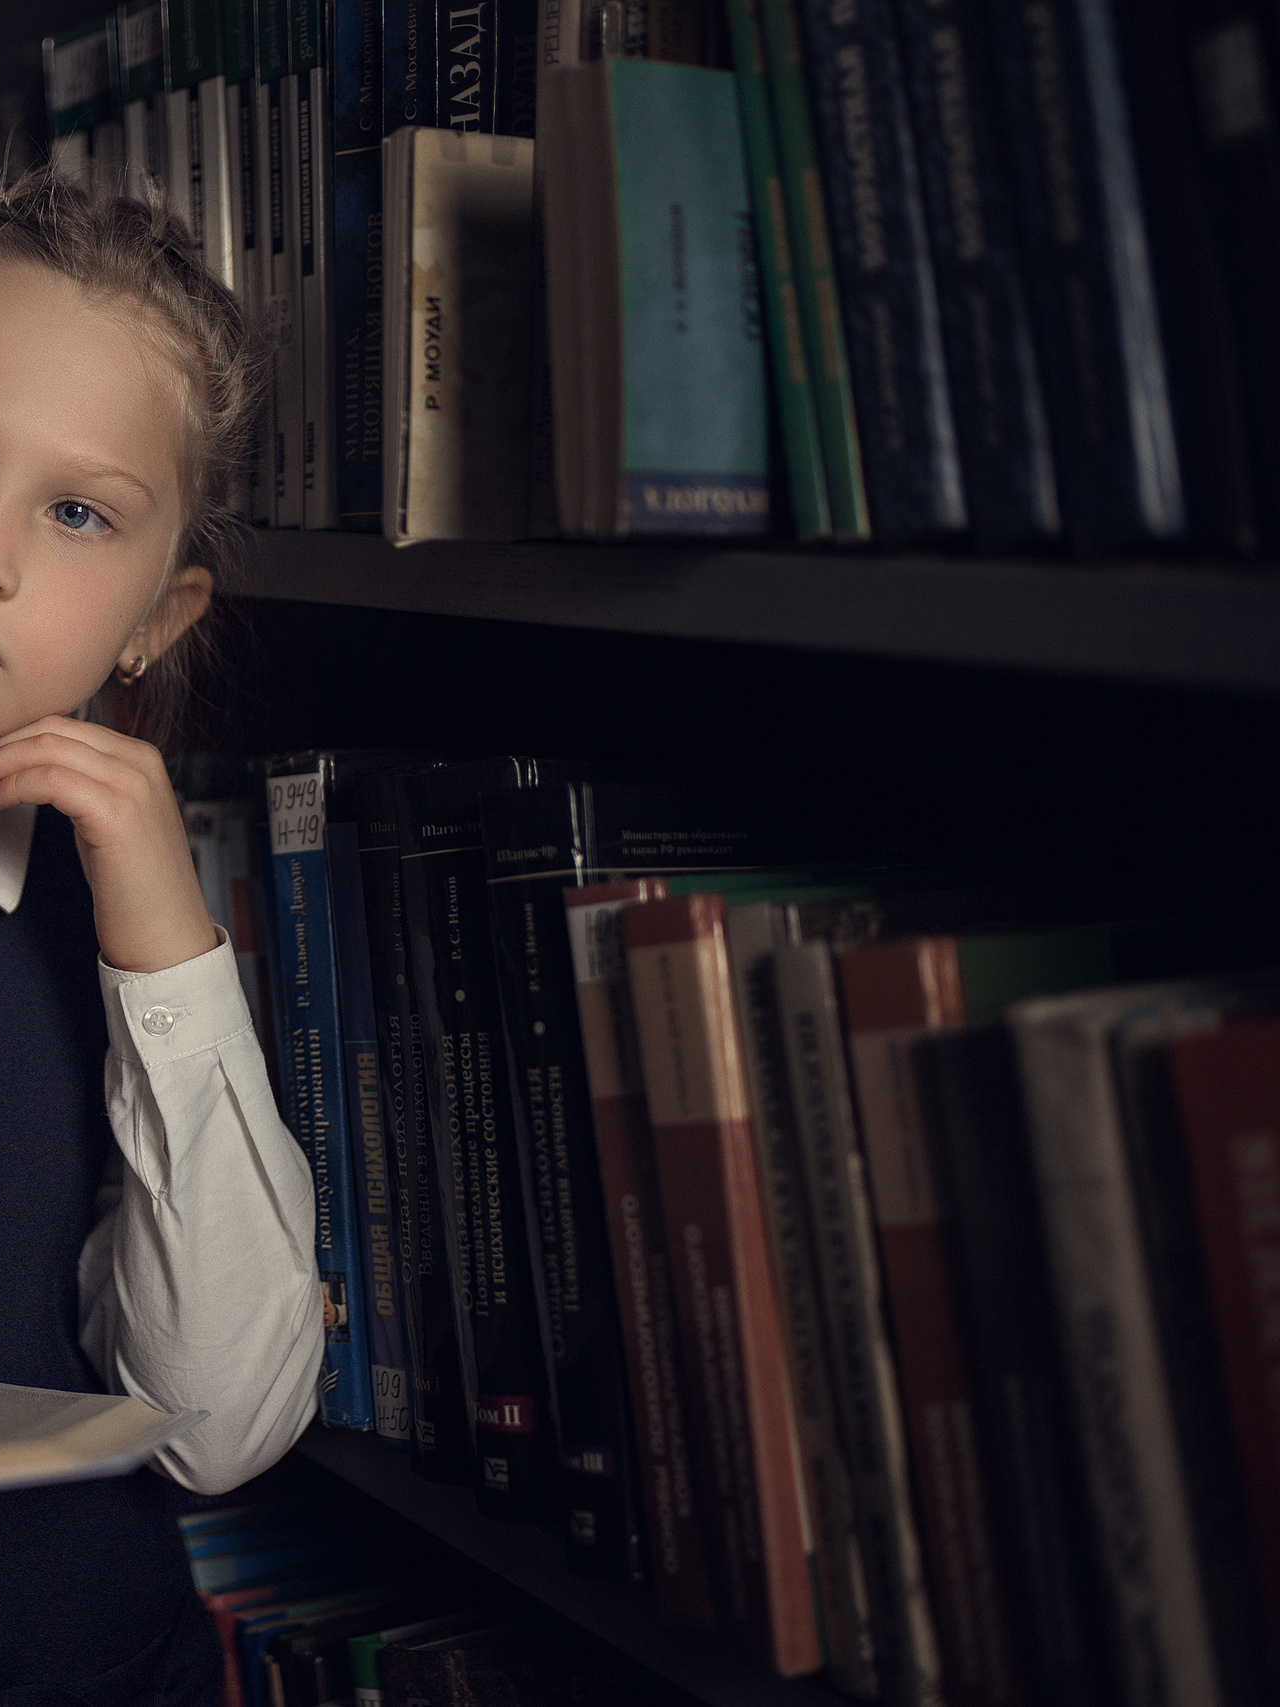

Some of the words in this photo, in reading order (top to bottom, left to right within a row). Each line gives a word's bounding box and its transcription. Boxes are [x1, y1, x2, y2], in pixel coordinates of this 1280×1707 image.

[359, 110, 374, 132] С.
[404, 98, 419, 121] С.
[366, 211, 384, 301] БОГОВ
[424, 296, 442, 381] МОУДИ
[344, 327, 361, 460] МАШИНА,
[362, 308, 383, 461] ТВОРЯЩАЯ
[425, 390, 441, 410] Р.
[391, 871, 402, 917] Немов
[392, 922, 403, 937] С.
[447, 875, 460, 925] Немов
[449, 928, 461, 945] С.
[523, 901, 539, 955] Немов
[296, 991, 311, 1008] Р.
[451, 948, 463, 961] Р.
[525, 957, 540, 977] С.
[528, 978, 542, 993] Р.
[292, 1027, 311, 1143] ПРАКТИКА
[459, 1031, 480, 1133] процессы
[476, 1031, 496, 1143] состояния
[547, 1065, 570, 1172] личности
[308, 1028, 335, 1252] консультирования
[355, 1052, 388, 1215] ПСИХОЛОГИЯ
[398, 1187, 413, 1285] Общая
[417, 1174, 433, 1278] Введение
[456, 1211, 474, 1311] Общая
[466, 1139, 490, 1318] Познавательные
[483, 1147, 506, 1286] психические
[557, 1178, 581, 1313] Психология
[370, 1224, 395, 1317] ОБЩАЯ
[493, 1290, 508, 1305] и
[544, 1252, 566, 1359] Общая
[472, 1401, 499, 1425] Том
[502, 1404, 523, 1426] II
[582, 1451, 604, 1473] III
